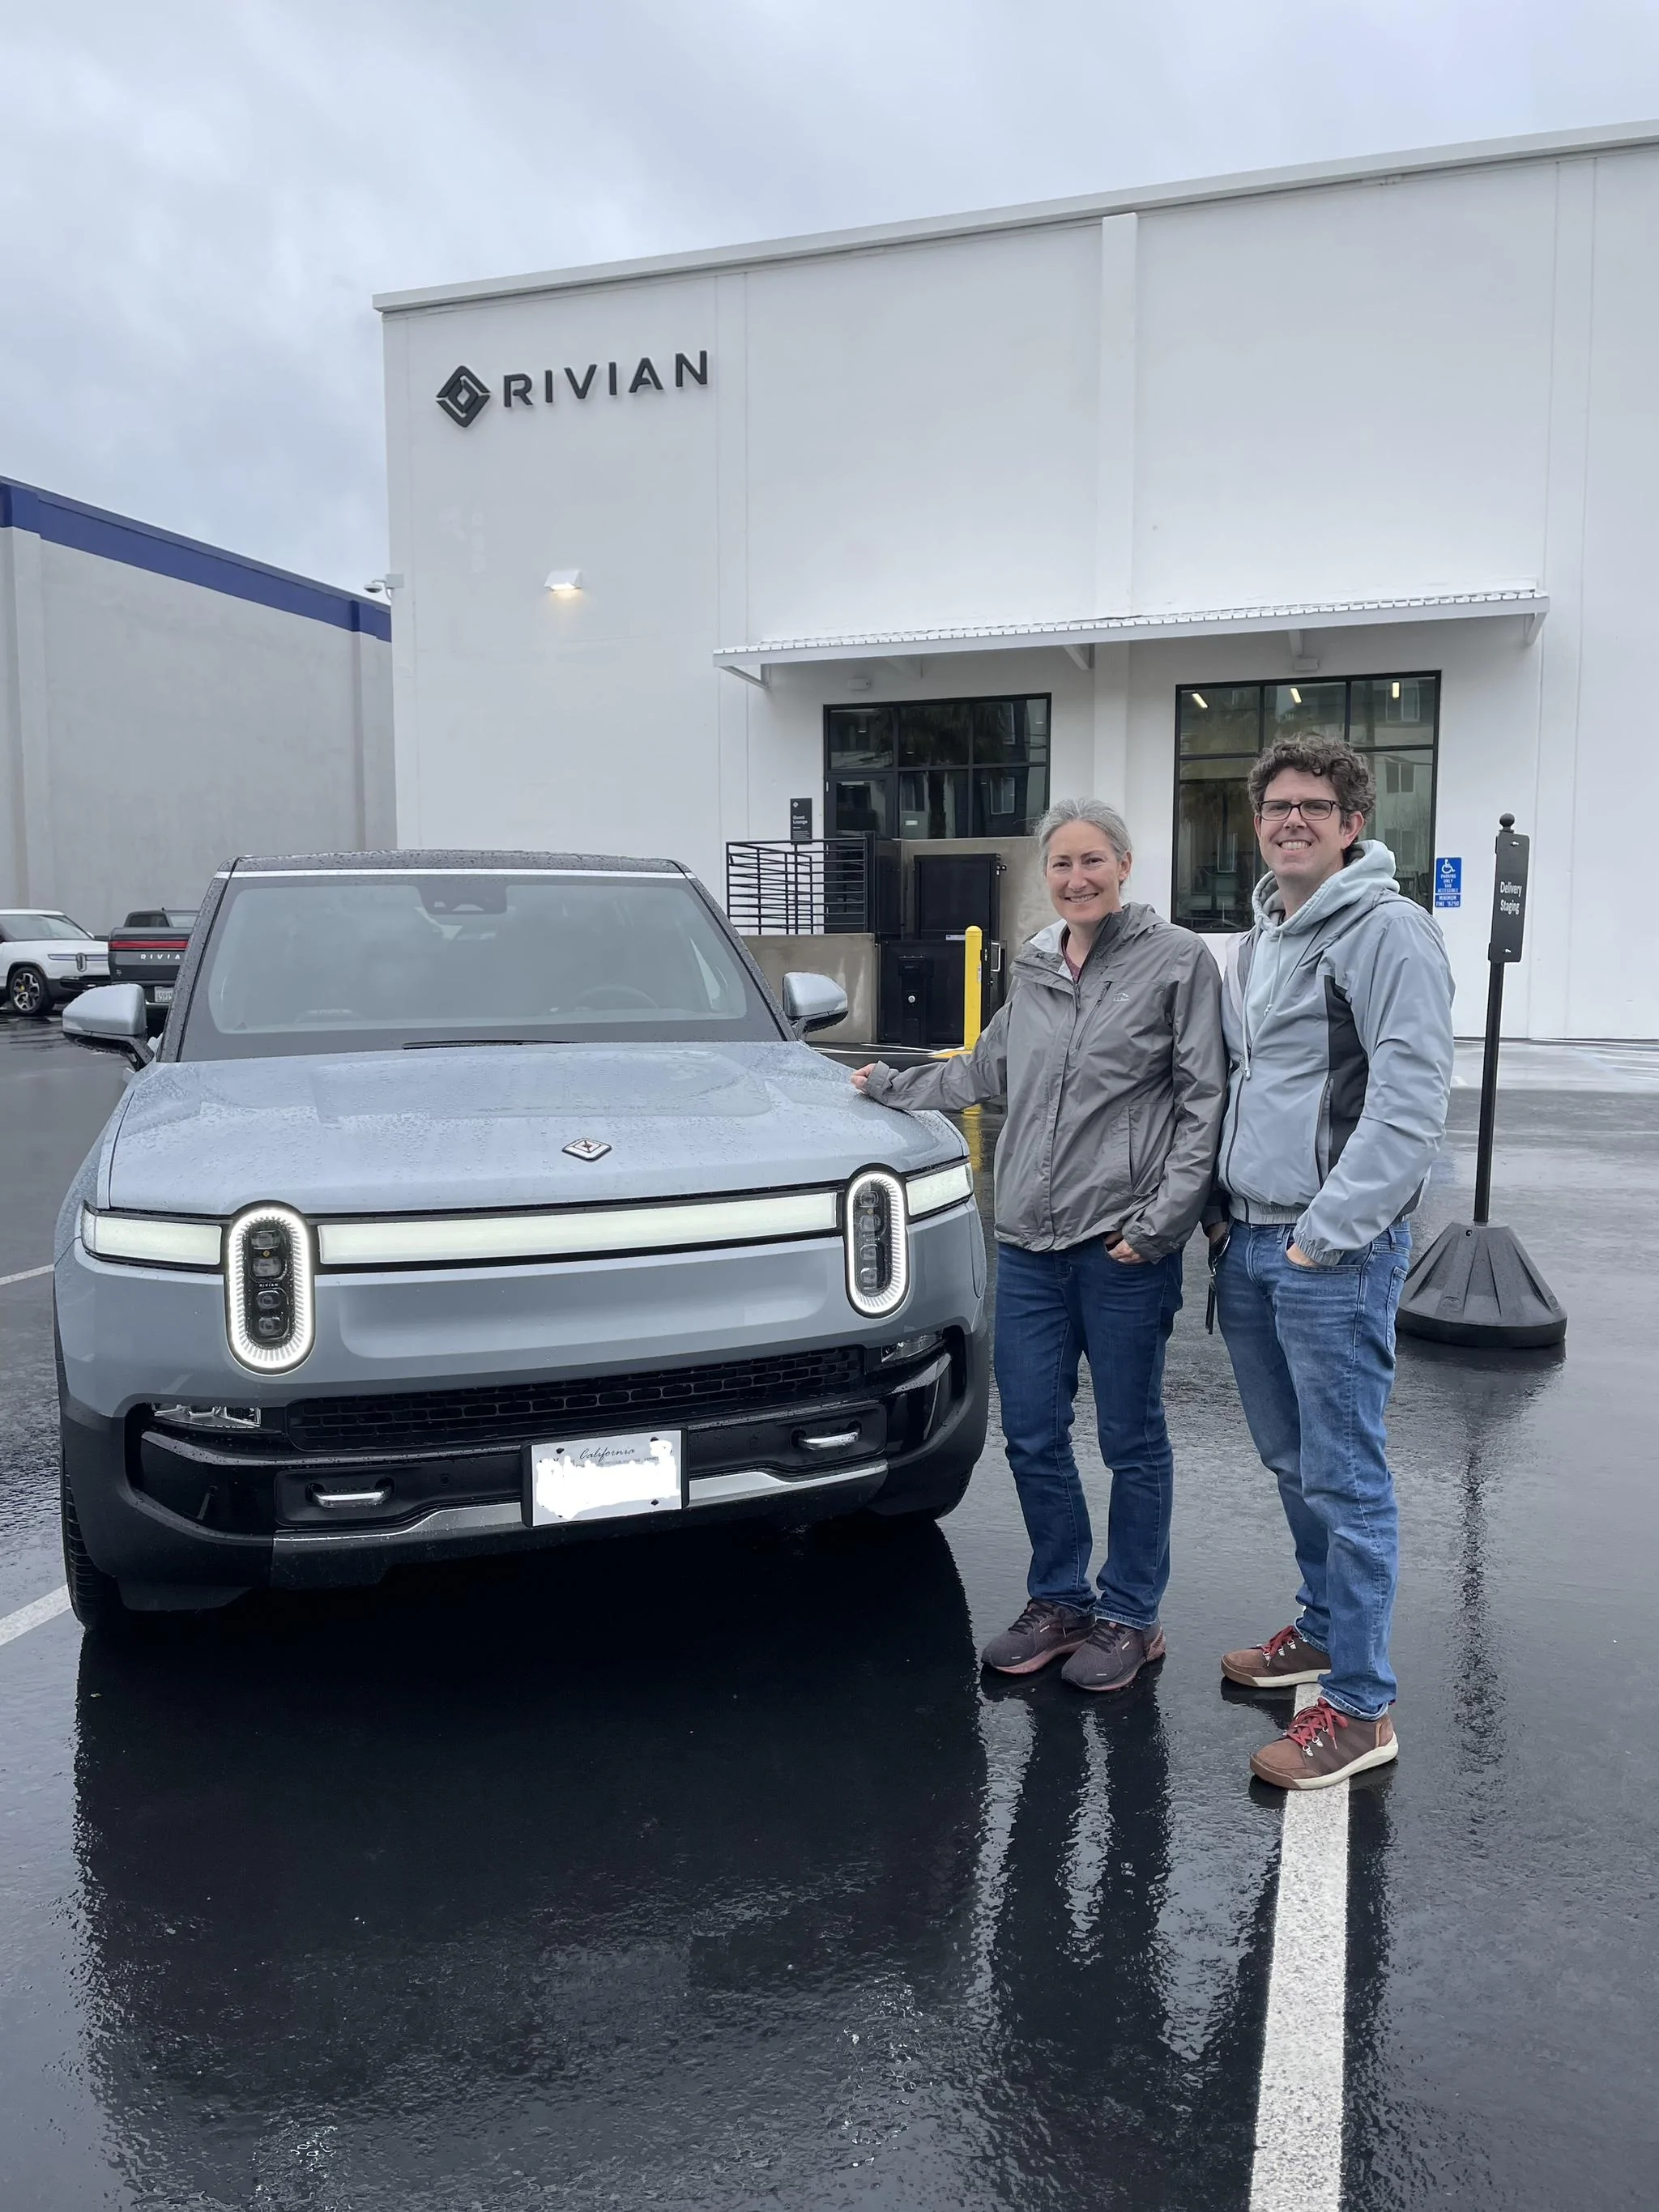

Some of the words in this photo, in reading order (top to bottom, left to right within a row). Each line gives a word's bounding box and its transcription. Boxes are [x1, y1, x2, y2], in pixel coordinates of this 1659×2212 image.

[503, 350, 709, 408] RIVIAN
[1499, 880, 1523, 897] Delivery
[1499, 899, 1520, 915] Staging
[579, 1447, 636, 1463] California
